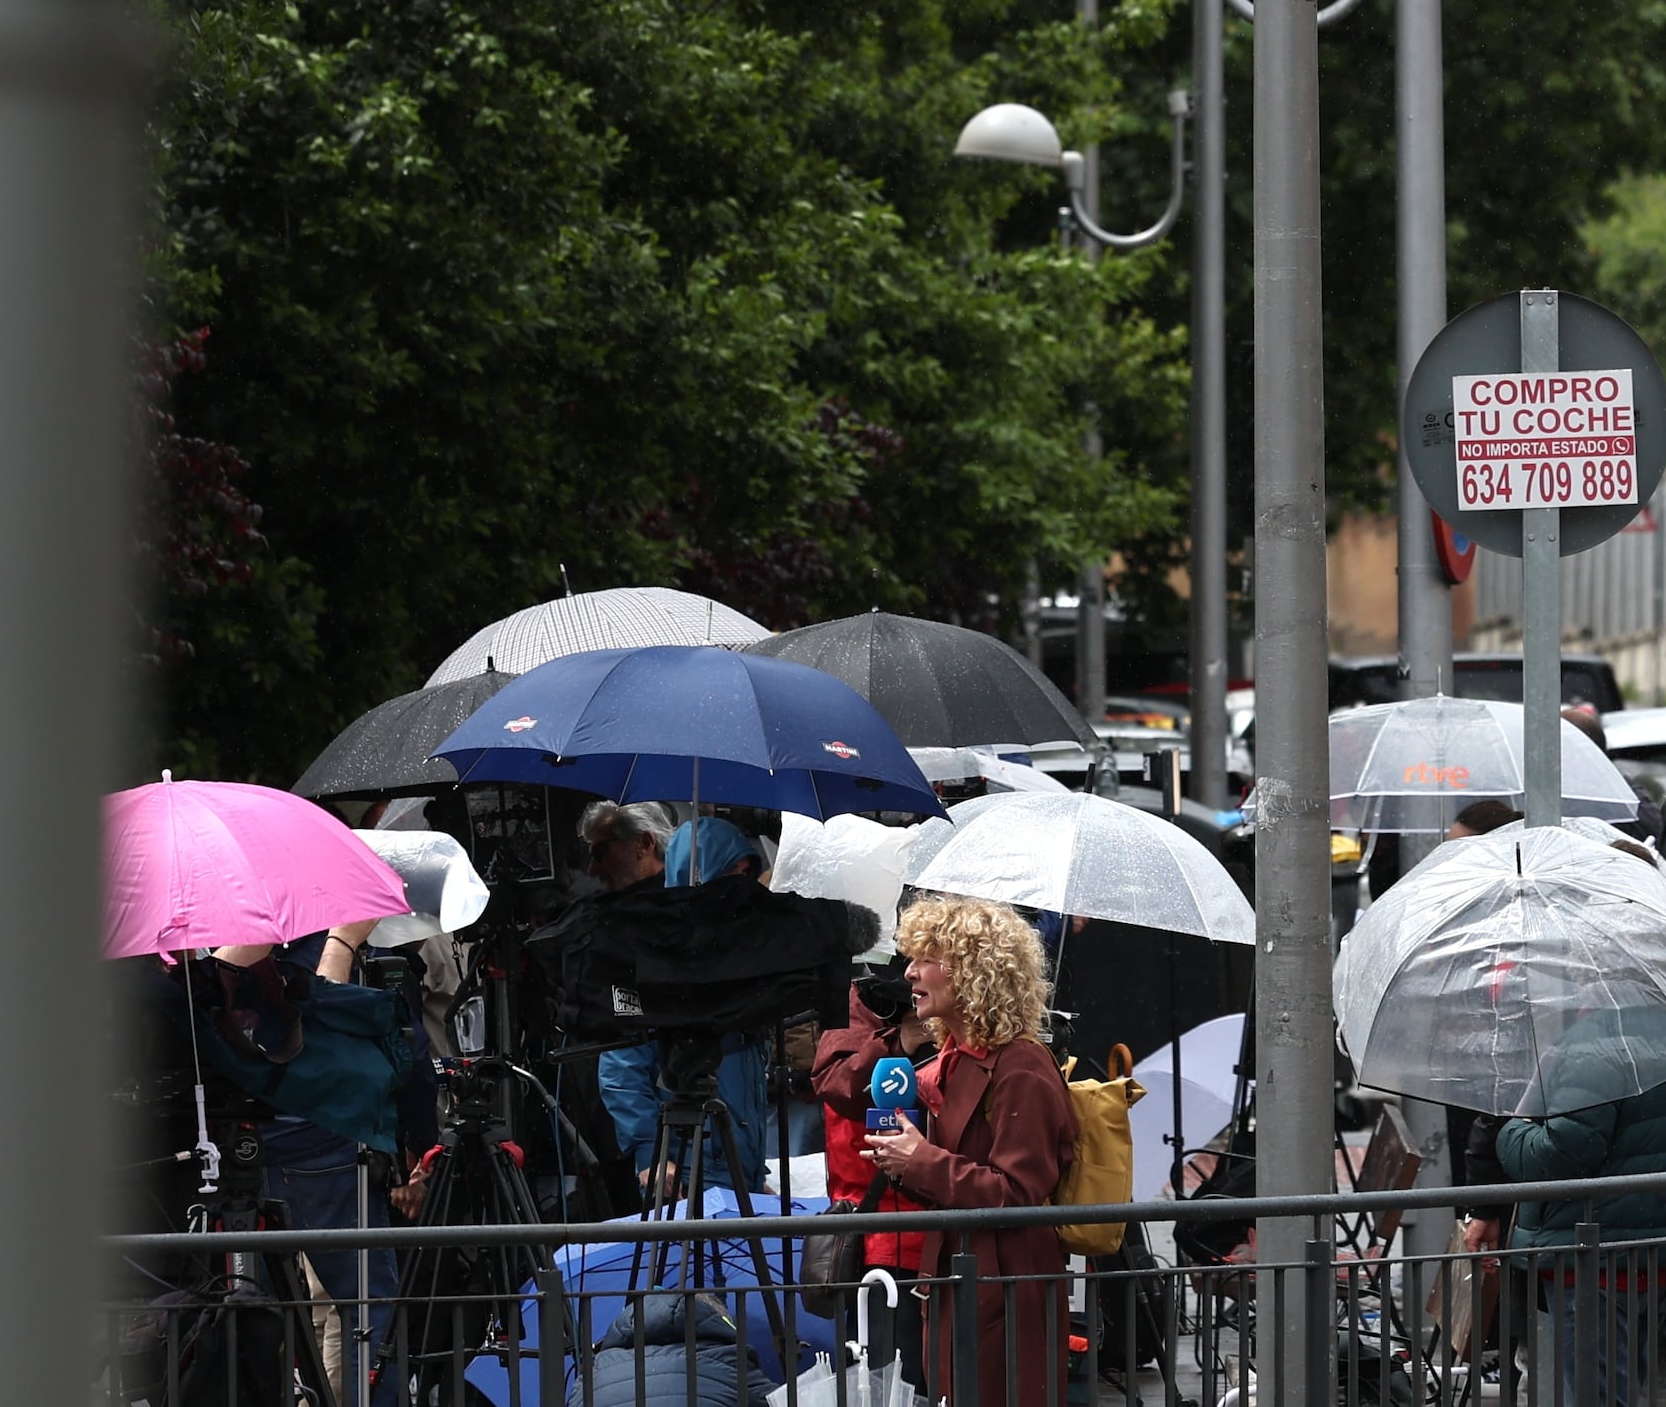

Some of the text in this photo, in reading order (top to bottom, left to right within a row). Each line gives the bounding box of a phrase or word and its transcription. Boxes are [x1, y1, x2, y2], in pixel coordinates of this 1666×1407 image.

[1470, 377, 1620, 406] COMPRO
[1458, 410, 1501, 436] TU
[1512, 406, 1633, 435] COCHE
[1461, 439, 1609, 458] NO IMPORTA ESTADO
[1462, 459, 1633, 505] 634 709 889
[1403, 760, 1470, 790] rtve
